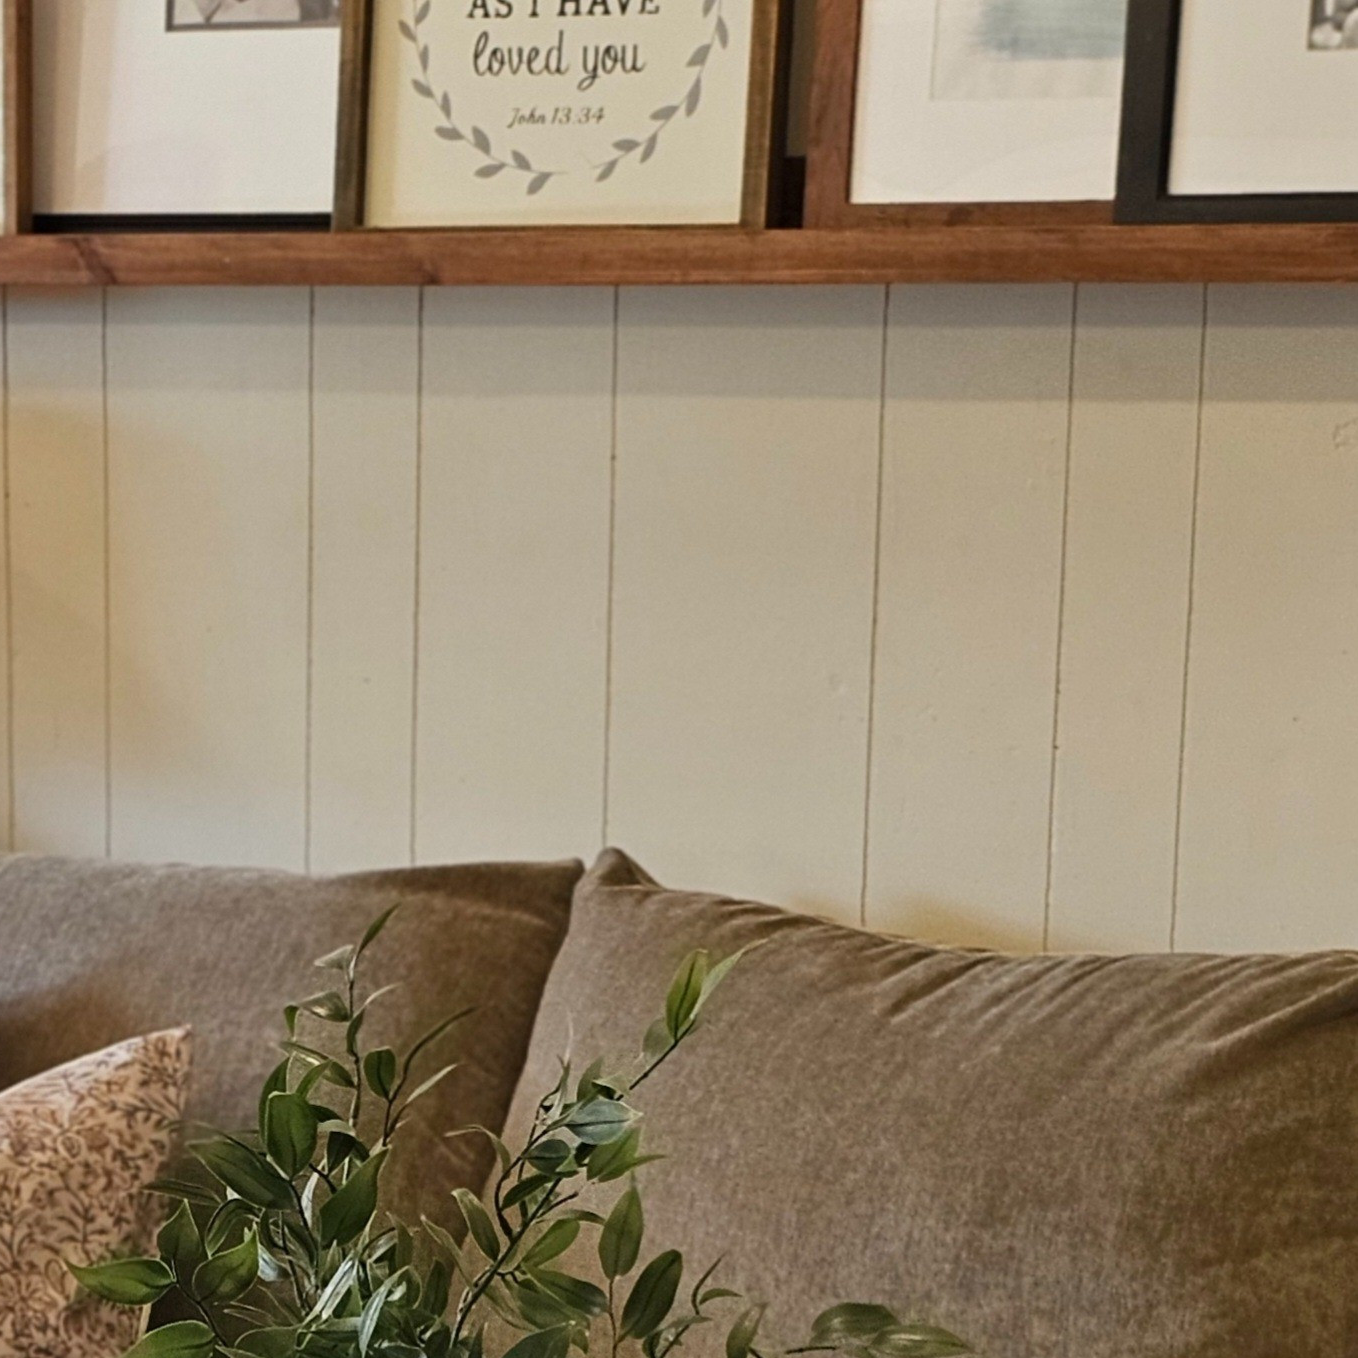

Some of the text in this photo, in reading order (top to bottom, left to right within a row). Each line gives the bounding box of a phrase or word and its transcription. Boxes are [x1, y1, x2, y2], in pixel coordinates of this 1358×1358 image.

[472, 29, 647, 91] loved you
[506, 106, 546, 128] John
